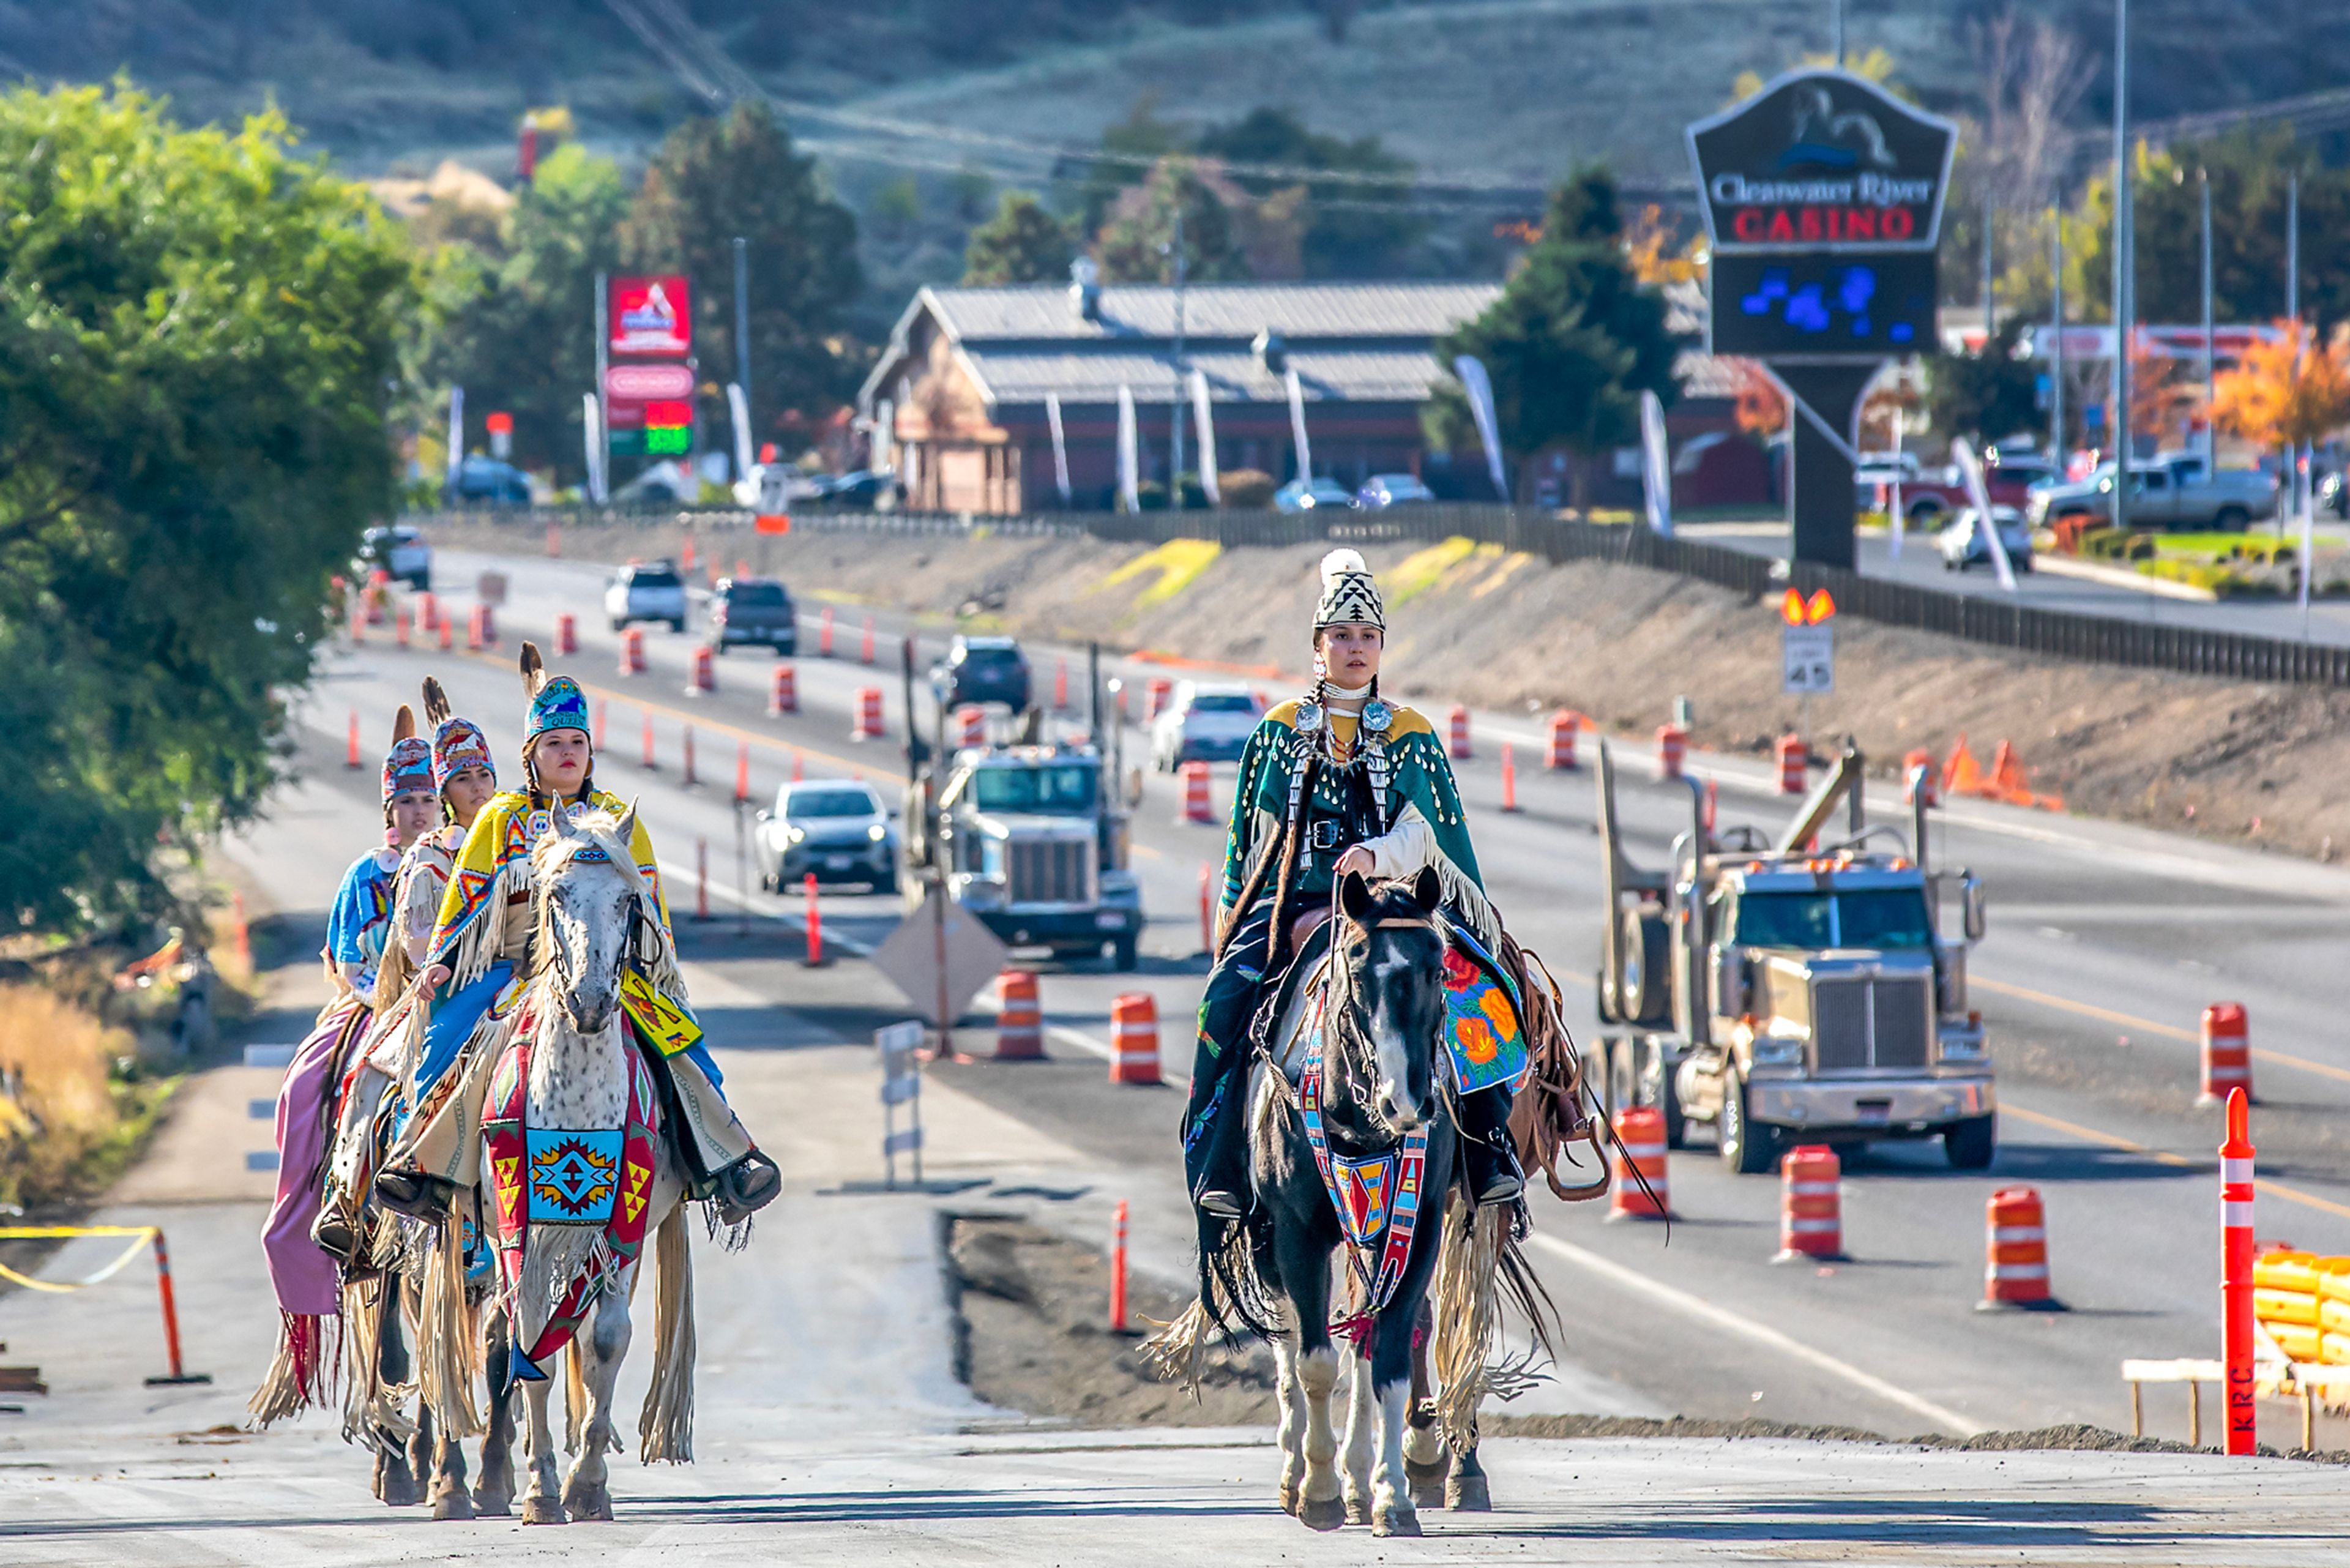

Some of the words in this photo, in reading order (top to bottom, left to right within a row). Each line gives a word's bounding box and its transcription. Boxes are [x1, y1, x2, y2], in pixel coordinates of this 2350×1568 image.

[1711, 173, 1851, 204] Clearwater
[1859, 173, 1928, 207] River
[1734, 206, 1914, 241] CASINO
[1789, 662, 1830, 685] 45
[551, 717, 584, 726] QUEEN
[2230, 1368, 2256, 1432] KRC
